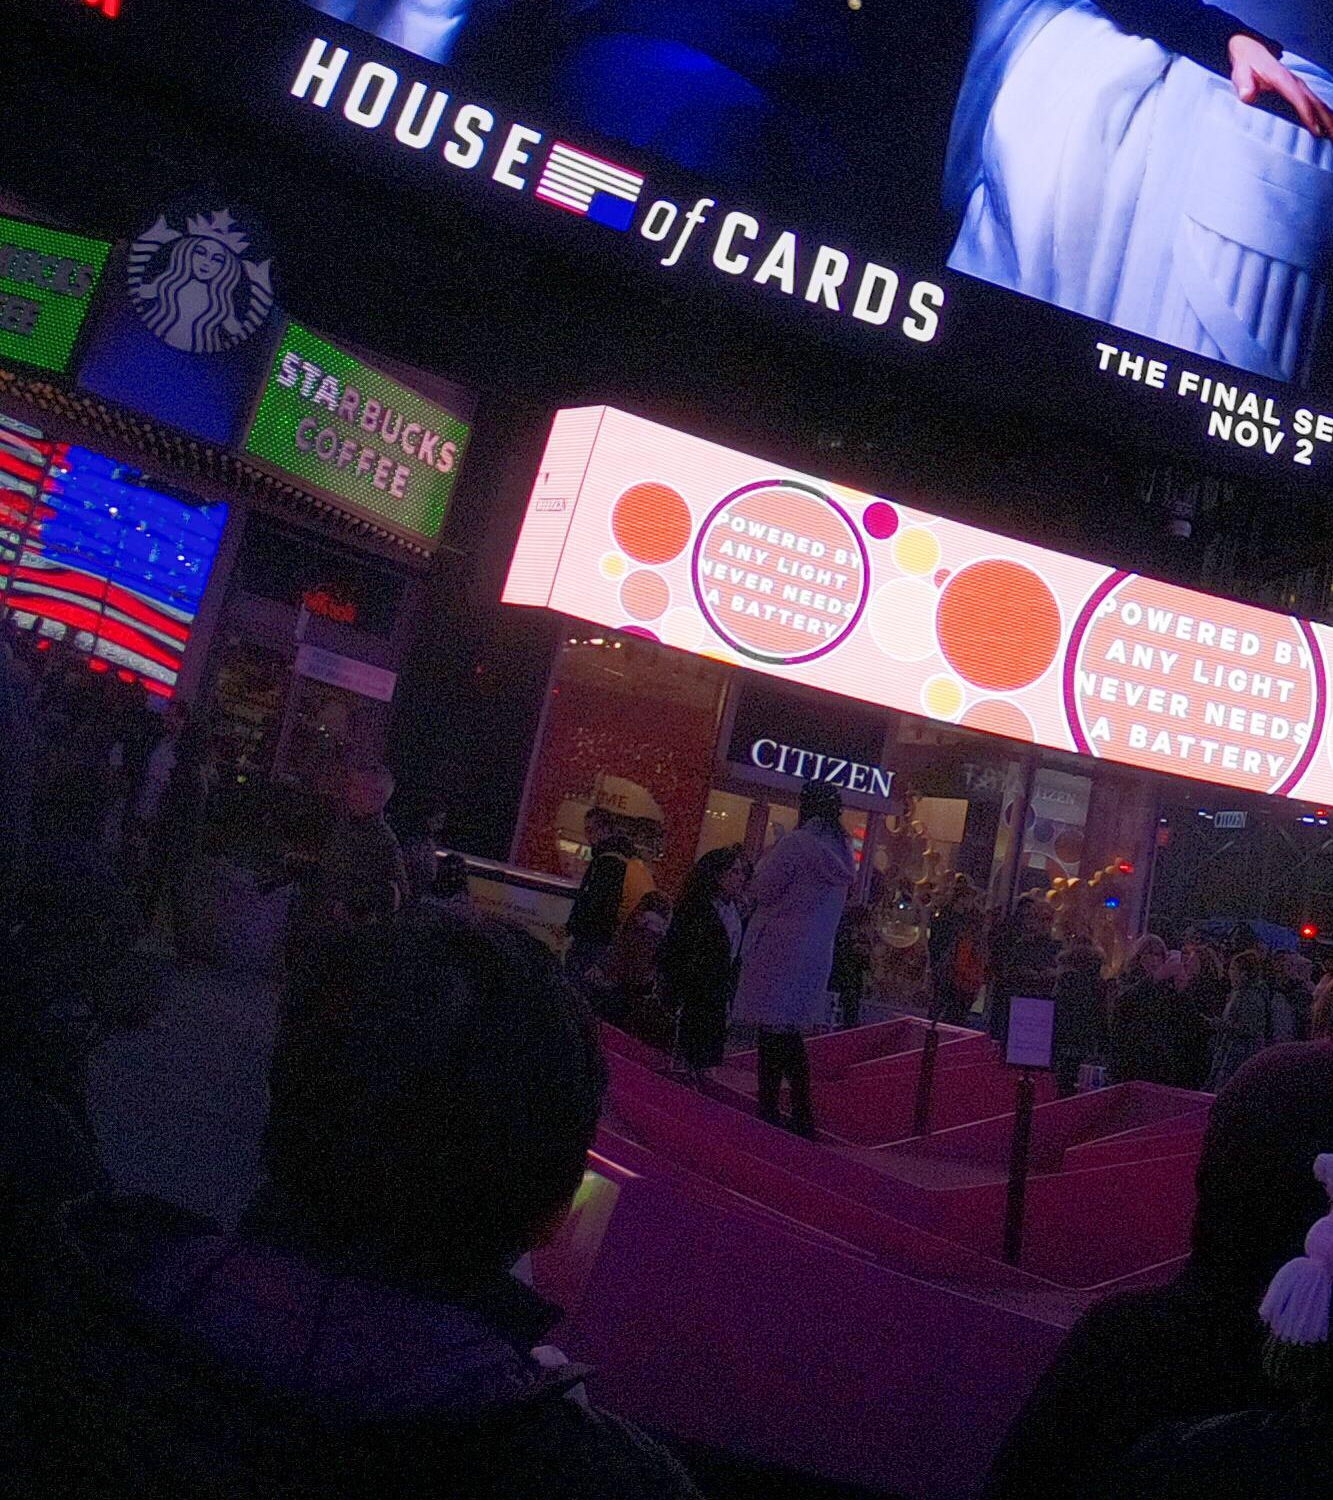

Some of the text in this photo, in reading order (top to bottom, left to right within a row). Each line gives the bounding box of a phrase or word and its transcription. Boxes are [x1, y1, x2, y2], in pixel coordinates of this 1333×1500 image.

[290, 37, 945, 342] HOUSE of CARDS
[276, 352, 456, 473] STARBUCKS
[1096, 342, 1168, 389] THE
[1177, 371, 1281, 426] FINAL
[296, 417, 410, 499] COFFEE
[1208, 411, 1314, 465] NOV 2
[713, 512, 861, 569] POWERED BY
[719, 539, 848, 589] ANY LIGHT
[701, 558, 857, 618] NEVER NEEDS
[707, 589, 839, 639] A BATTERY
[1097, 596, 1311, 669] POWERED BY
[1105, 639, 1296, 703] ANY LIGHT
[1079, 671, 1310, 746] NEVER NEEDS
[751, 738, 897, 799] CITIZEN
[1091, 717, 1286, 778] A BATTERY
[1213, 810, 1249, 829] CITIZEN
